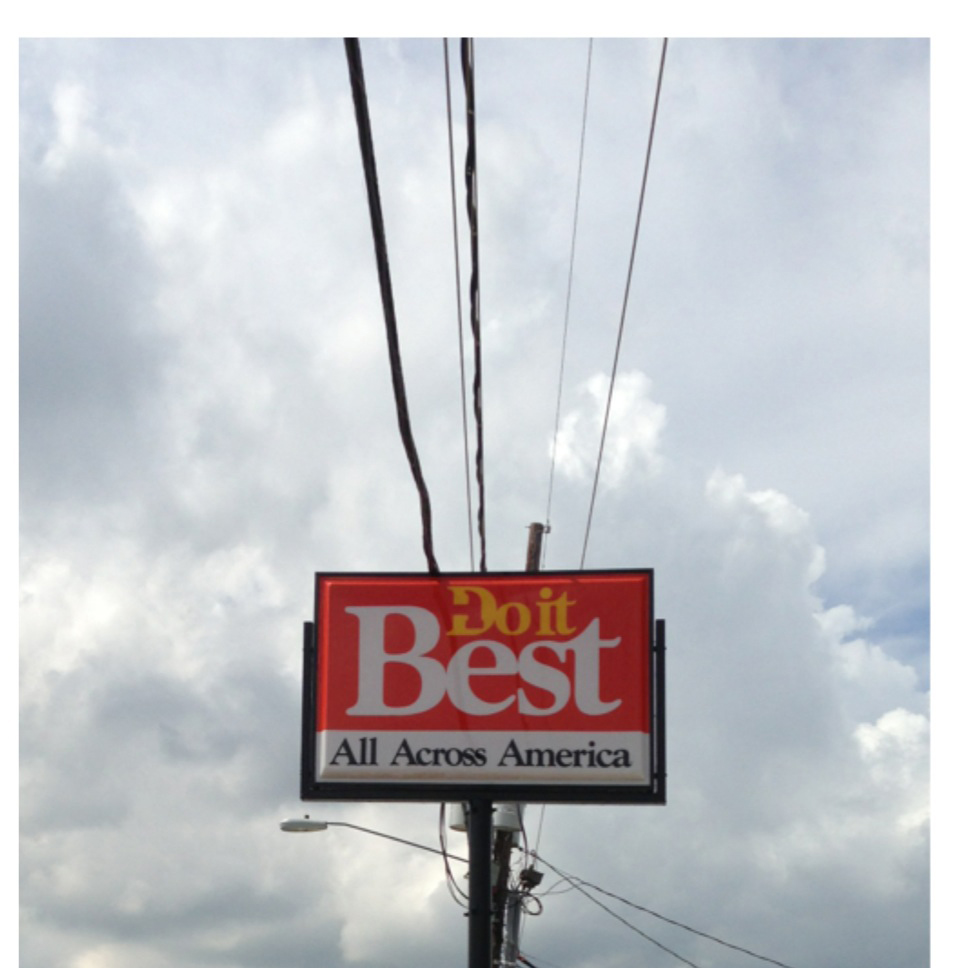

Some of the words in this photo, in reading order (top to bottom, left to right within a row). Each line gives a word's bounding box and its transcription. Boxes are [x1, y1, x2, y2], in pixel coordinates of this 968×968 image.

[535, 587, 577, 636] it
[344, 605, 622, 716] Best
[330, 737, 378, 766] All
[390, 738, 487, 767] Across
[497, 739, 631, 768] America
